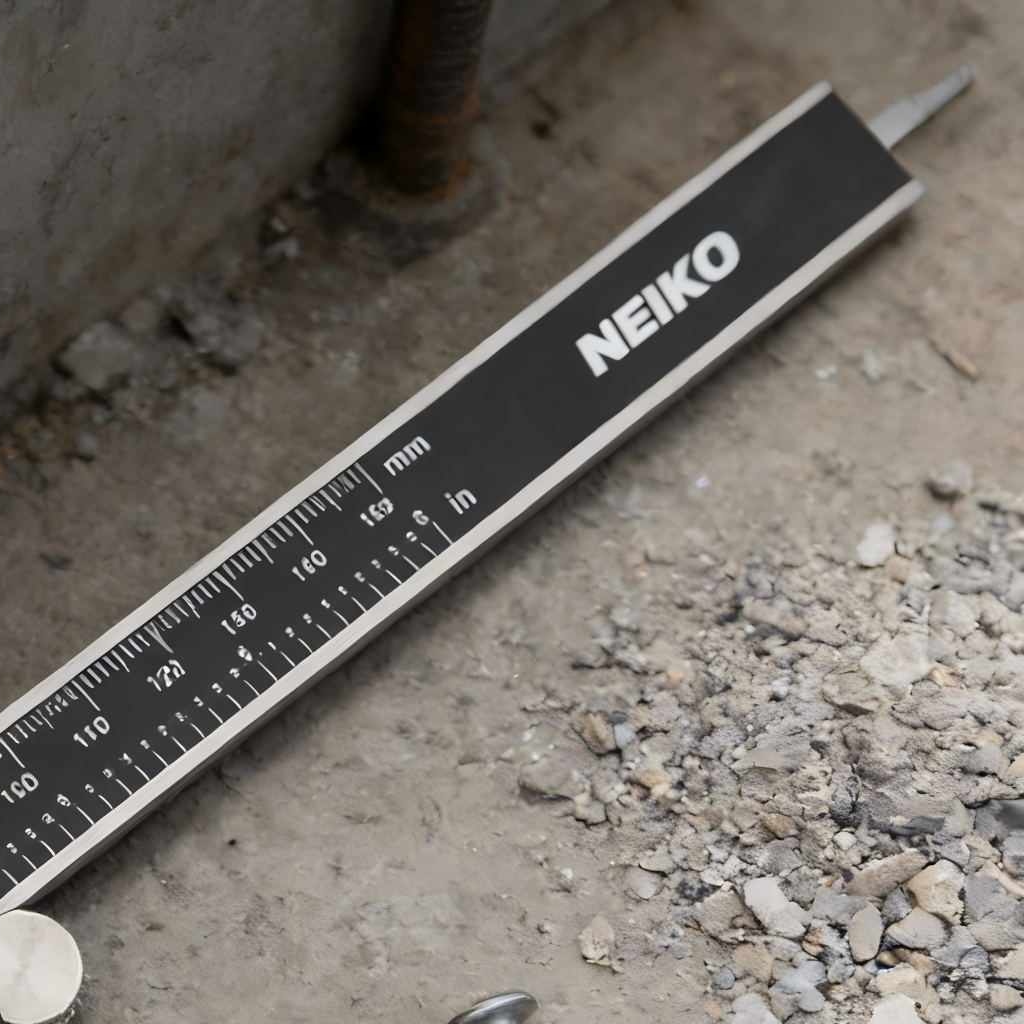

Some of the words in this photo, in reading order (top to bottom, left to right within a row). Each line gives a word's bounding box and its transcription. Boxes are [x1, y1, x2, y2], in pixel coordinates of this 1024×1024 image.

[575, 230, 741, 378] NEIKO
[383, 435, 432, 477] mm
[444, 488, 477, 515] in
